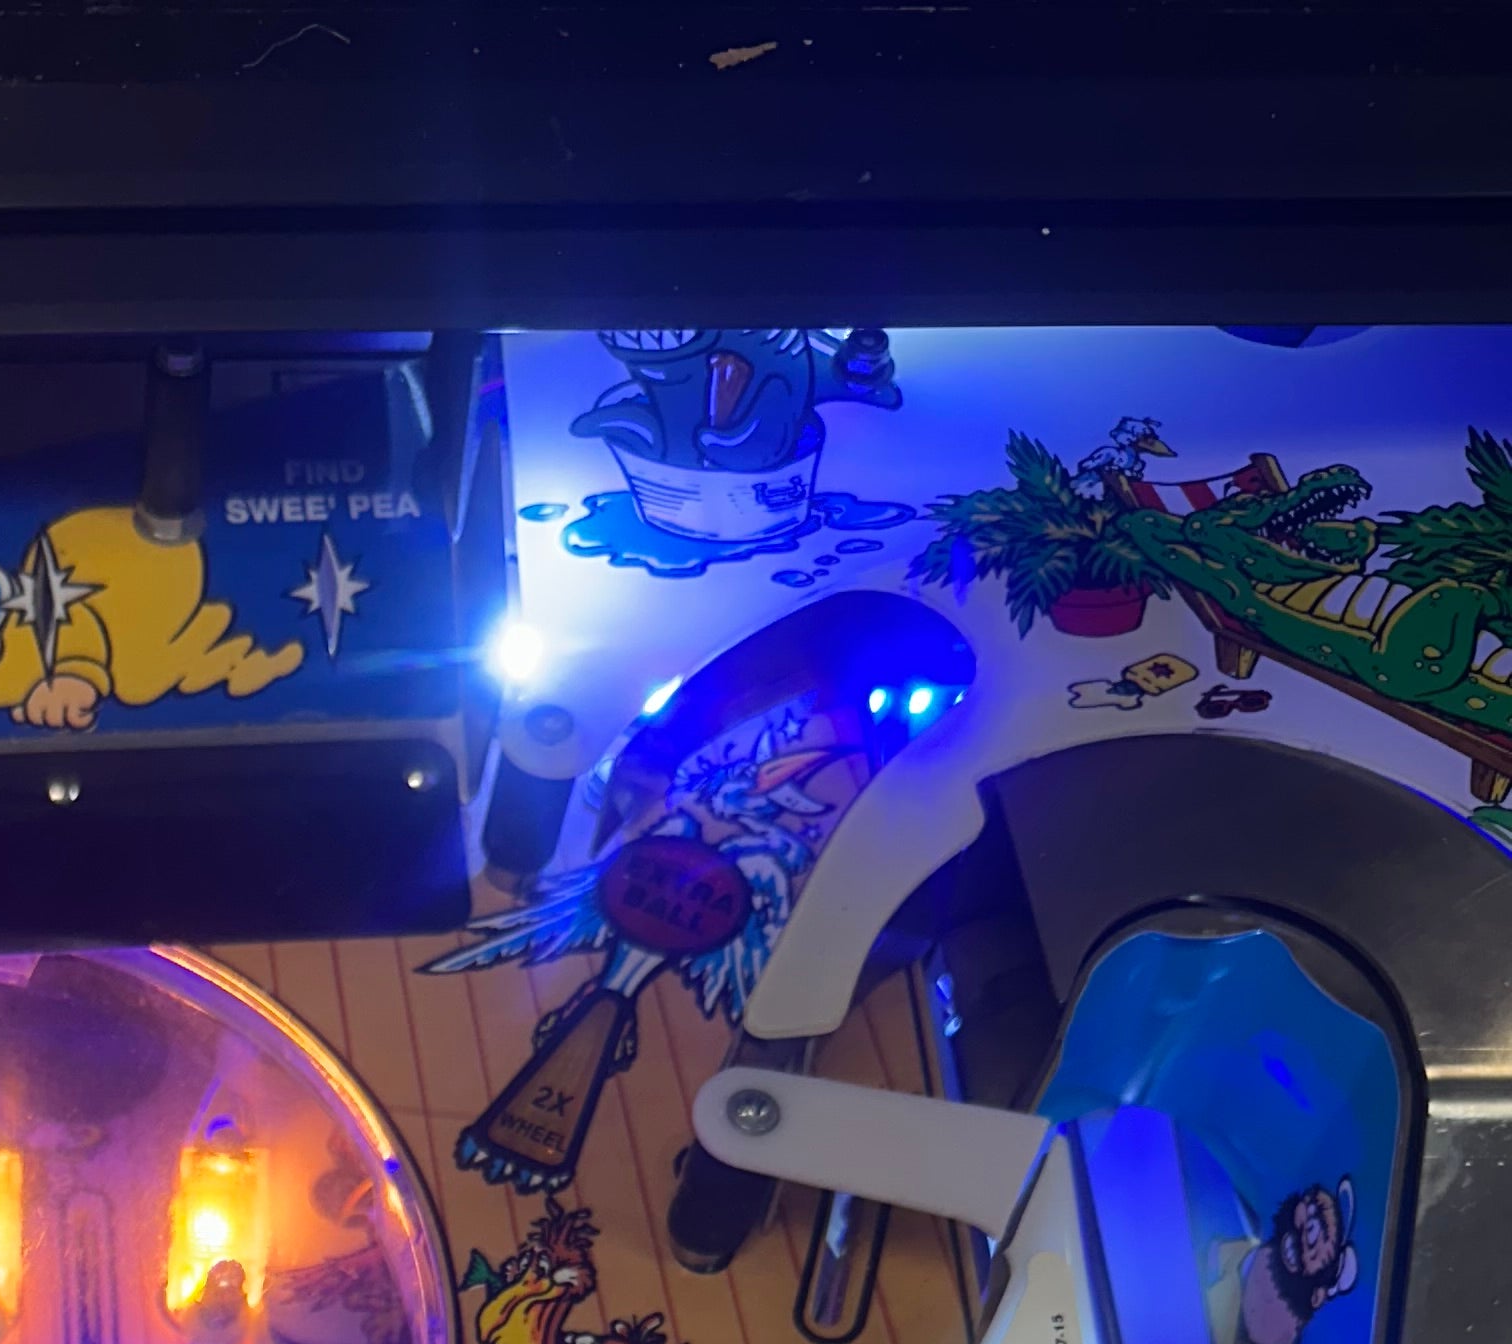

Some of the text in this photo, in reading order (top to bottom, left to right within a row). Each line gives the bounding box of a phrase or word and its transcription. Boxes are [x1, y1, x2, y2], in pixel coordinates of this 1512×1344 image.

[284, 459, 365, 486] FIND
[347, 491, 422, 521] PEA
[531, 1085, 575, 1117] 2X
[498, 1112, 566, 1153] WHEEL
